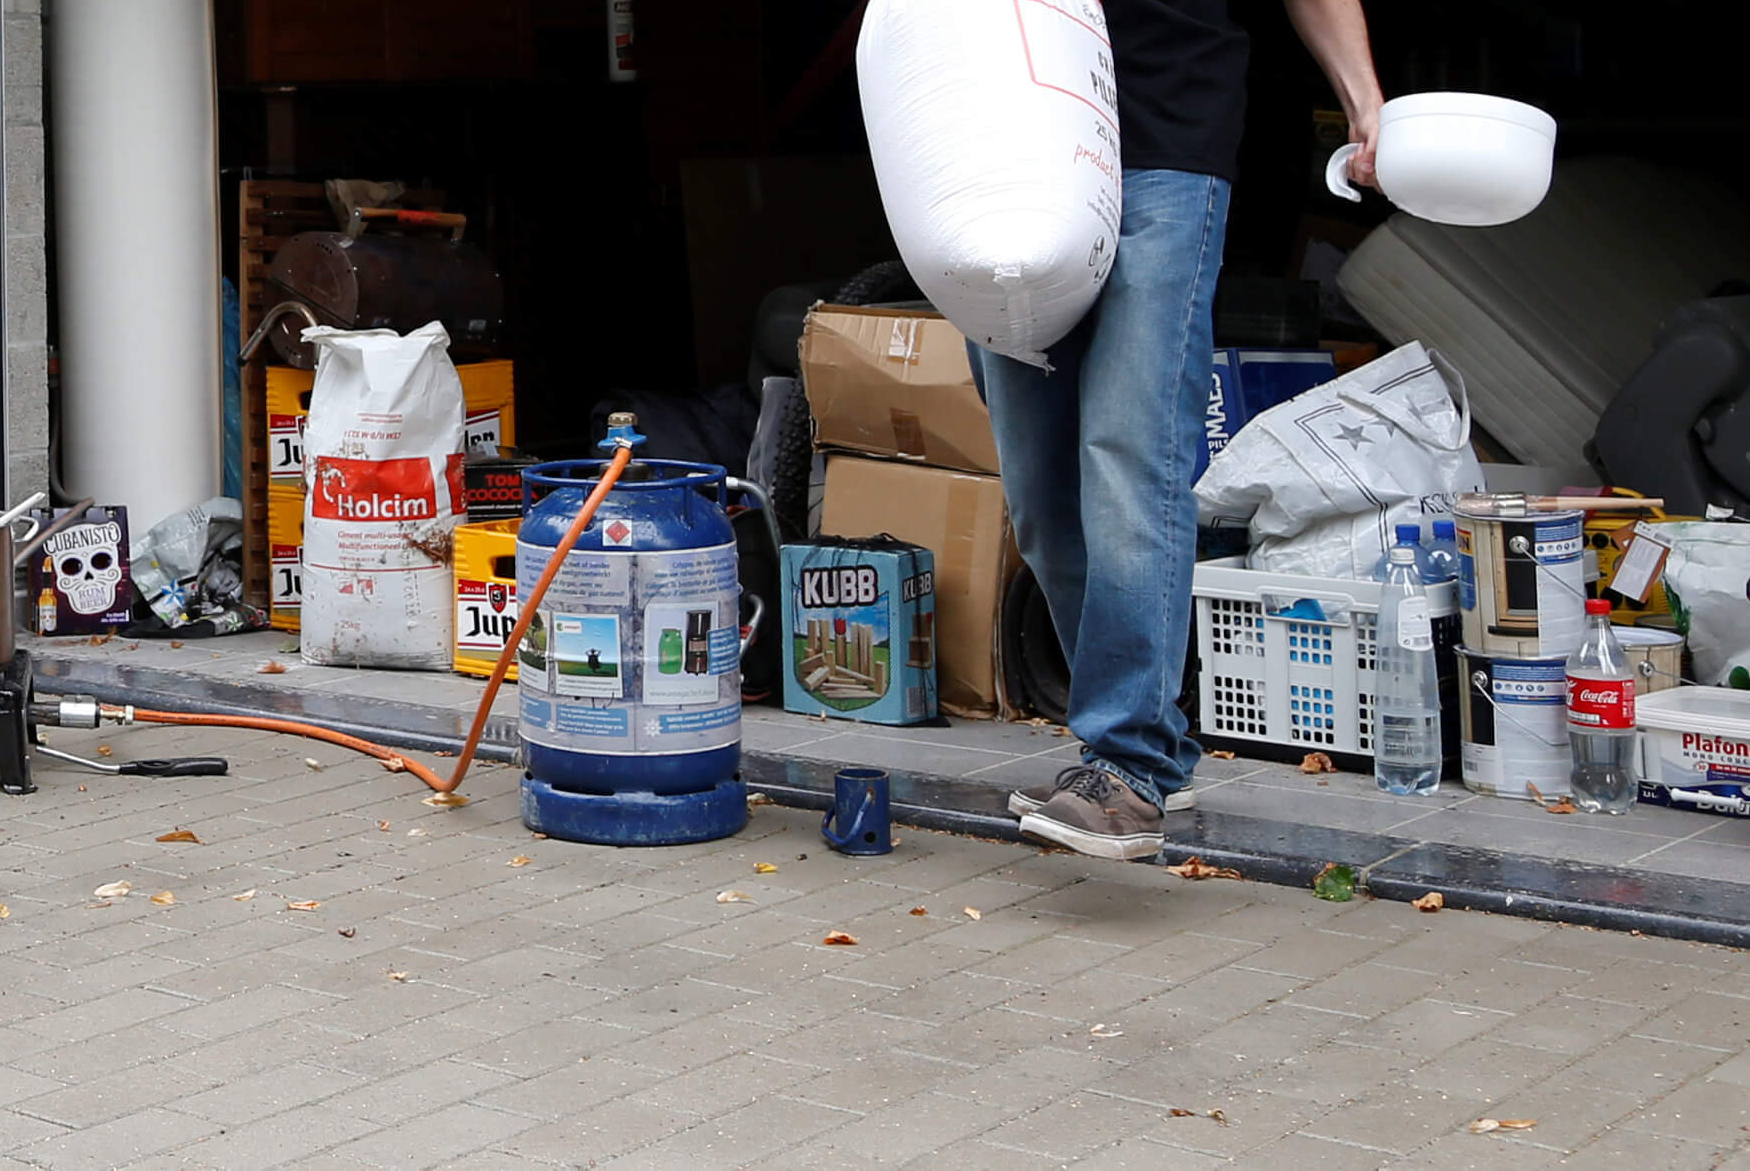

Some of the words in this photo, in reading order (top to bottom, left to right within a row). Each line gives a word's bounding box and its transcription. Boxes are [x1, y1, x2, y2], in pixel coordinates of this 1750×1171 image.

[1073, 143, 1114, 180] product
[337, 493, 428, 518] Holcim
[44, 522, 120, 554] CUBANISTO
[78, 586, 106, 599] RUM
[803, 568, 876, 606] KUBB
[1580, 688, 1619, 705] Coca-Cola
[1682, 750, 1714, 761] MONO
